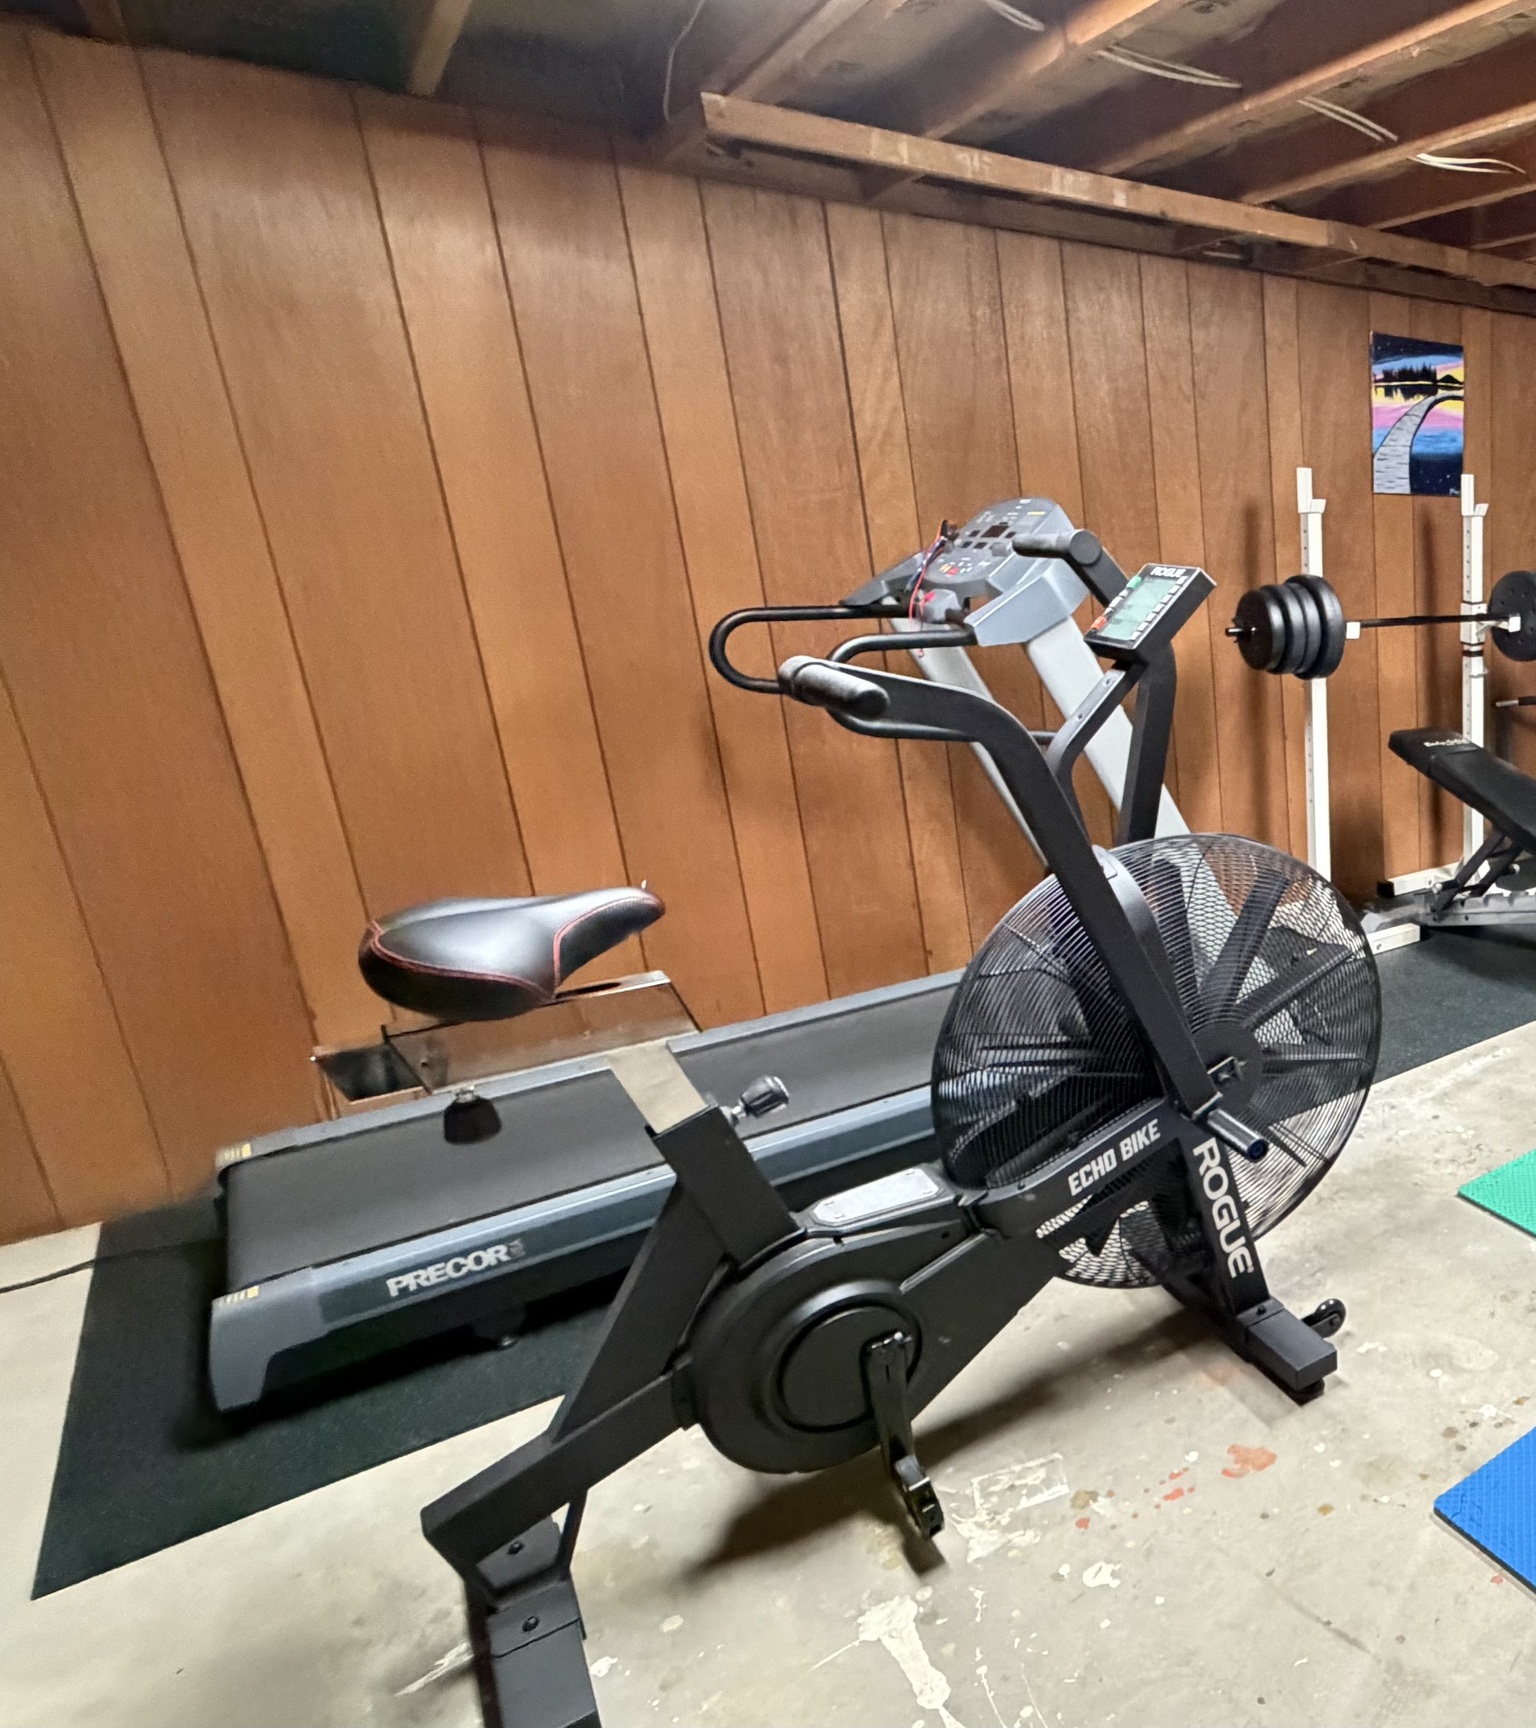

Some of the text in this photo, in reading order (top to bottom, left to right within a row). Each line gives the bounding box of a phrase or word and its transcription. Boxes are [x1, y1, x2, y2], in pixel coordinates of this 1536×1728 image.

[1150, 567, 1186, 577] ROGUE
[1068, 1118, 1161, 1196] ECHO BIKE
[1193, 1137, 1252, 1279] ROGUE
[385, 1244, 511, 1297] PRECOR
